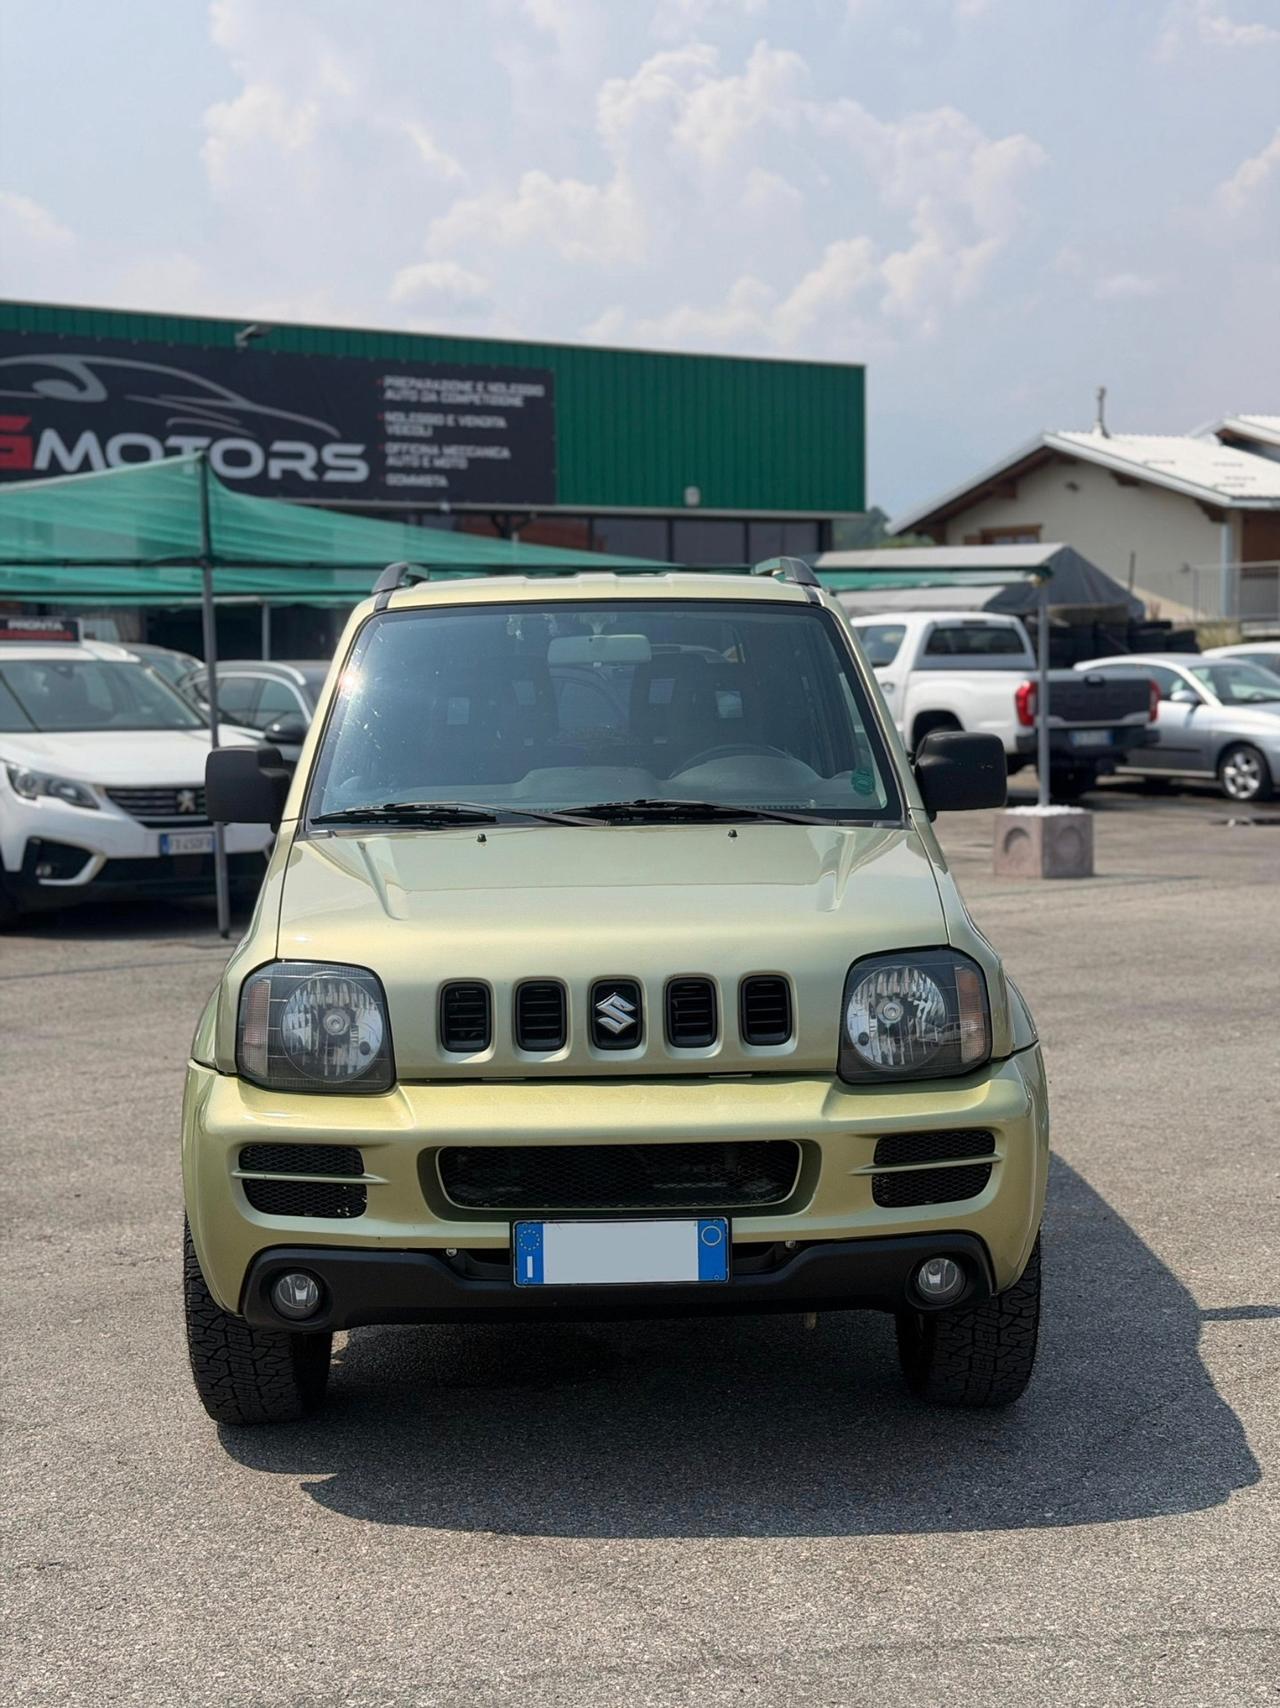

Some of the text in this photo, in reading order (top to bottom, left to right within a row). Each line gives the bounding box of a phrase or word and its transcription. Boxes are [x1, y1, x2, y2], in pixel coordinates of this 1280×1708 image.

[384, 376, 474, 391] PREPARAZIONE
[384, 389, 418, 402] AUTO
[440, 393, 525, 406] COMPETIZIONE
[384, 412, 445, 425] NOLEGGIO
[457, 415, 508, 428] VENDITA
[385, 424, 434, 437] VEICOLI
[385, 442, 511, 458] OFFICINA MECCANICA
[385, 455, 420, 467] AUTO
[432, 457, 469, 469] MOTO
